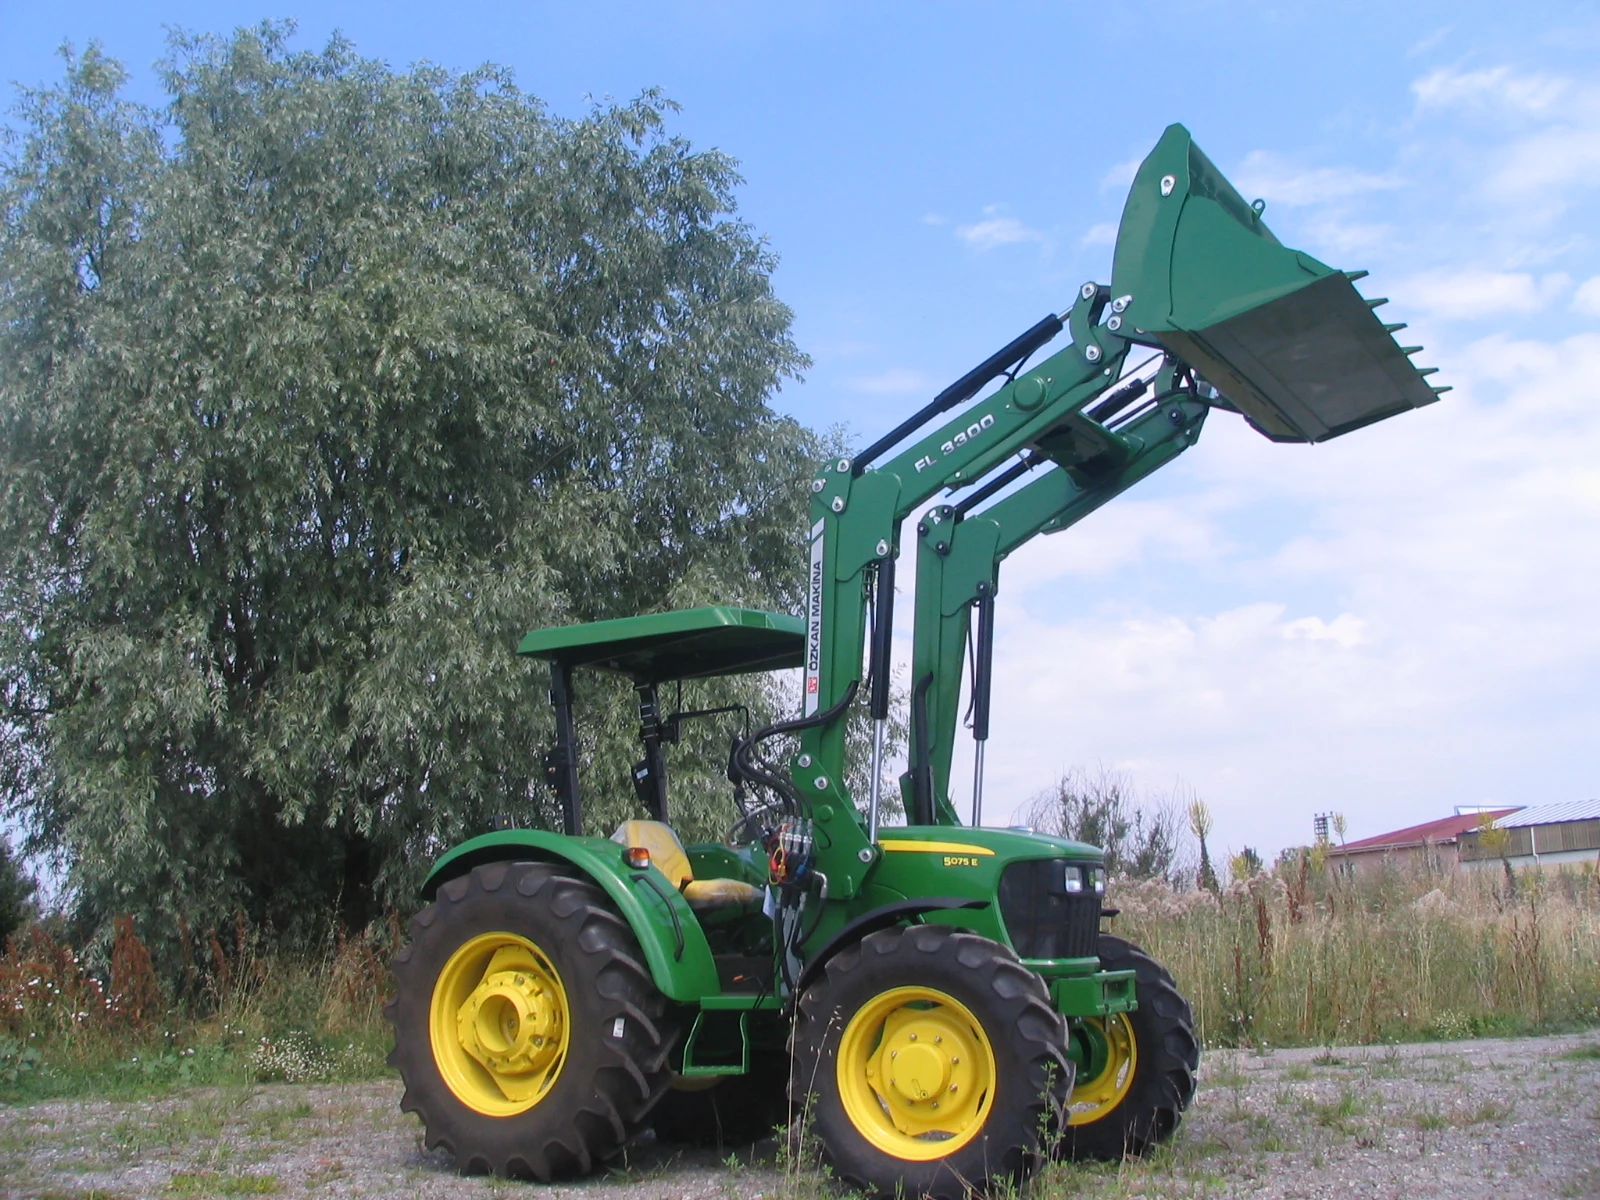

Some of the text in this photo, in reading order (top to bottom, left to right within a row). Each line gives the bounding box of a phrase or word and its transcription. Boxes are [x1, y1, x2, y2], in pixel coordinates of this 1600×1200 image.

[914, 413, 995, 473] FL 3300
[809, 560, 821, 671] ÖZKAN MAKİNA
[943, 857, 978, 866] 5075 E
